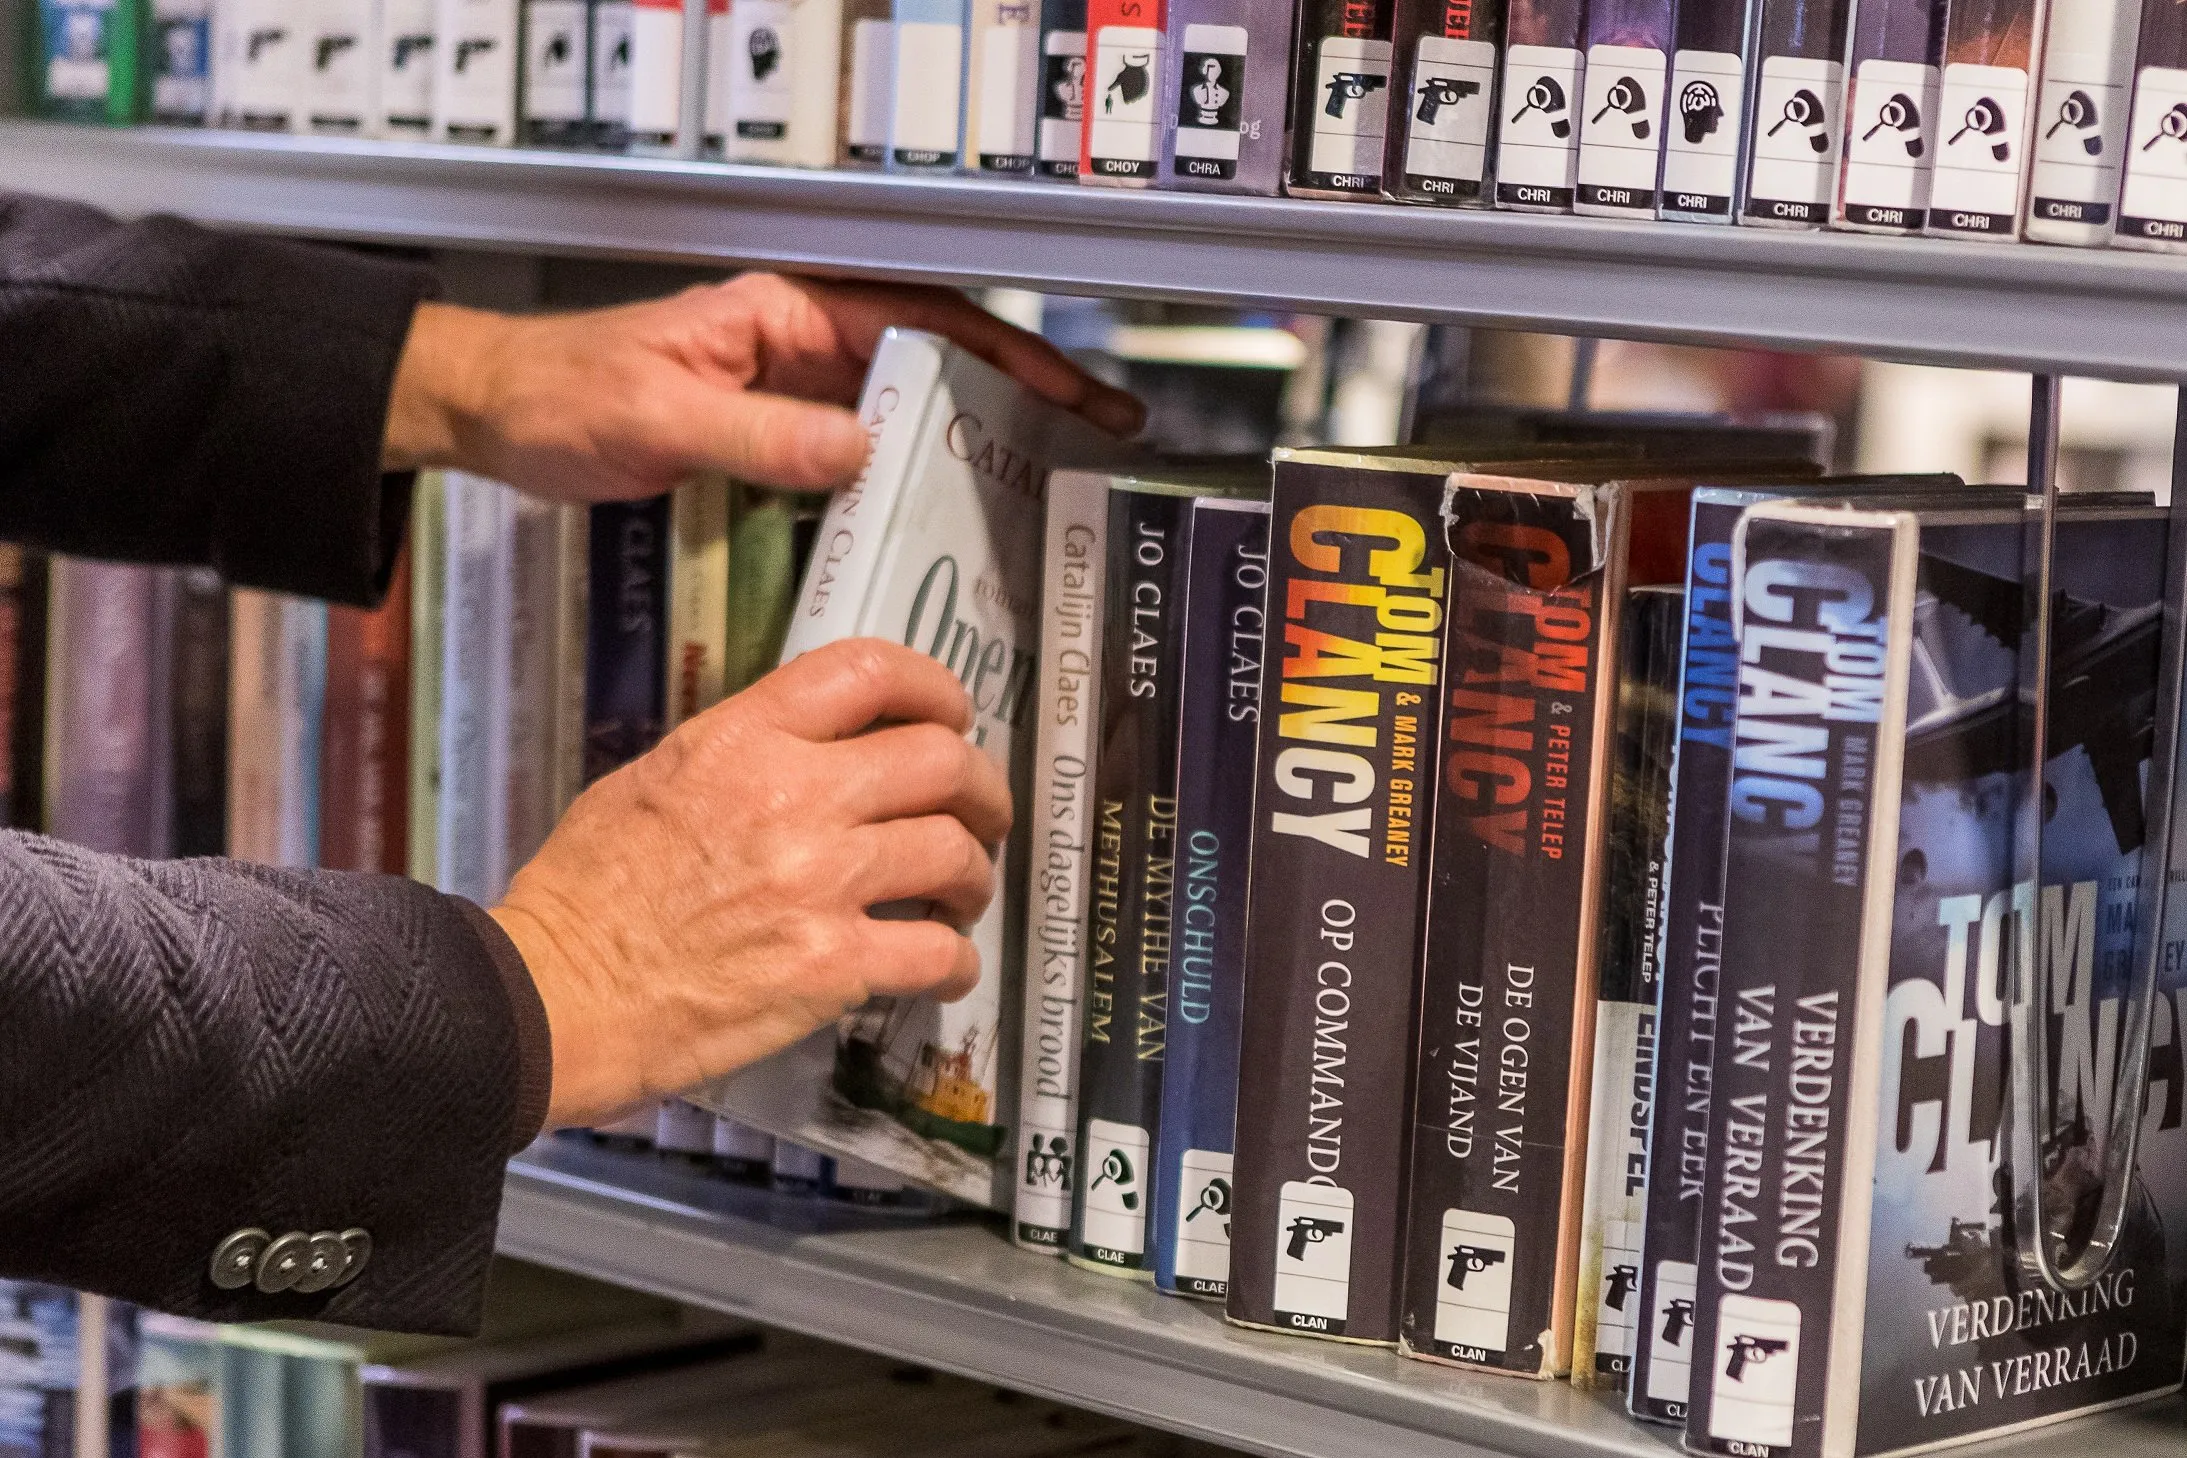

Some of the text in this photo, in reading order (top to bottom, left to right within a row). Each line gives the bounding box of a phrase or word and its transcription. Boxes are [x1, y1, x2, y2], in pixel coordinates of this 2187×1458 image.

[1055, 163, 1079, 175] CHO
[1106, 160, 1140, 174] CHOY
[1189, 161, 1221, 176] CHRA
[1332, 174, 1364, 188] CHRI
[1422, 179, 1454, 195] CHRI
[1517, 187, 1551, 202] CHRI
[1597, 188, 1630, 204] CHRI
[1677, 194, 1707, 209] CHRI
[1773, 203, 1809, 218] CHRI
[1867, 208, 1903, 223] CHRI
[1952, 213, 1990, 229] CHRI
[2049, 203, 2082, 219] CHRI
[2146, 221, 2184, 238] CHRI
[810, 530, 854, 617] CLAES
[1130, 522, 1164, 698] JO CLAES
[1056, 523, 1096, 727] Catalijn Claes
[1229, 544, 1267, 722] JO CLAES
[1373, 566, 1445, 686] TOM
[1532, 583, 1592, 693] TOM
[1272, 503, 1427, 859] CLANCY
[1445, 520, 1571, 857] CLANCY
[1823, 616, 1890, 723] TOM
[1149, 794, 1177, 840] DE
[1385, 691, 1422, 868] & MARK GREANEY
[1540, 701, 1573, 860] & PETER TELEP
[1833, 735, 1868, 887] MARK GREANEY
[1037, 755, 1086, 1100] Ons dagelijks brood
[1092, 799, 1123, 1044] METHUSALEM
[1181, 830, 1220, 1025] ONSCHULD
[1320, 899, 1356, 952] OP
[1641, 861, 1660, 983] & PETER TELEP
[1938, 880, 2098, 1026] TOM
[1137, 991, 1168, 1061] VAN
[1446, 982, 1484, 1160] DE VIJAND
[1491, 962, 1535, 1195] DE OGEN VAN
[1717, 983, 1776, 1292] VAN VERRAAD
[1775, 991, 1839, 1270] VERDENKING
[1030, 1228, 1058, 1244] CLAE
[1097, 1248, 1125, 1264] CLAE
[1193, 1279, 1227, 1295] CLAE
[1292, 1313, 1328, 1331] CLAN
[1928, 1269, 2134, 1350] VERDENKING
[1451, 1344, 1486, 1362] CLAN
[1914, 1332, 2137, 1418] VAN VERRAAD
[1728, 1441, 1769, 1458] CLAN
